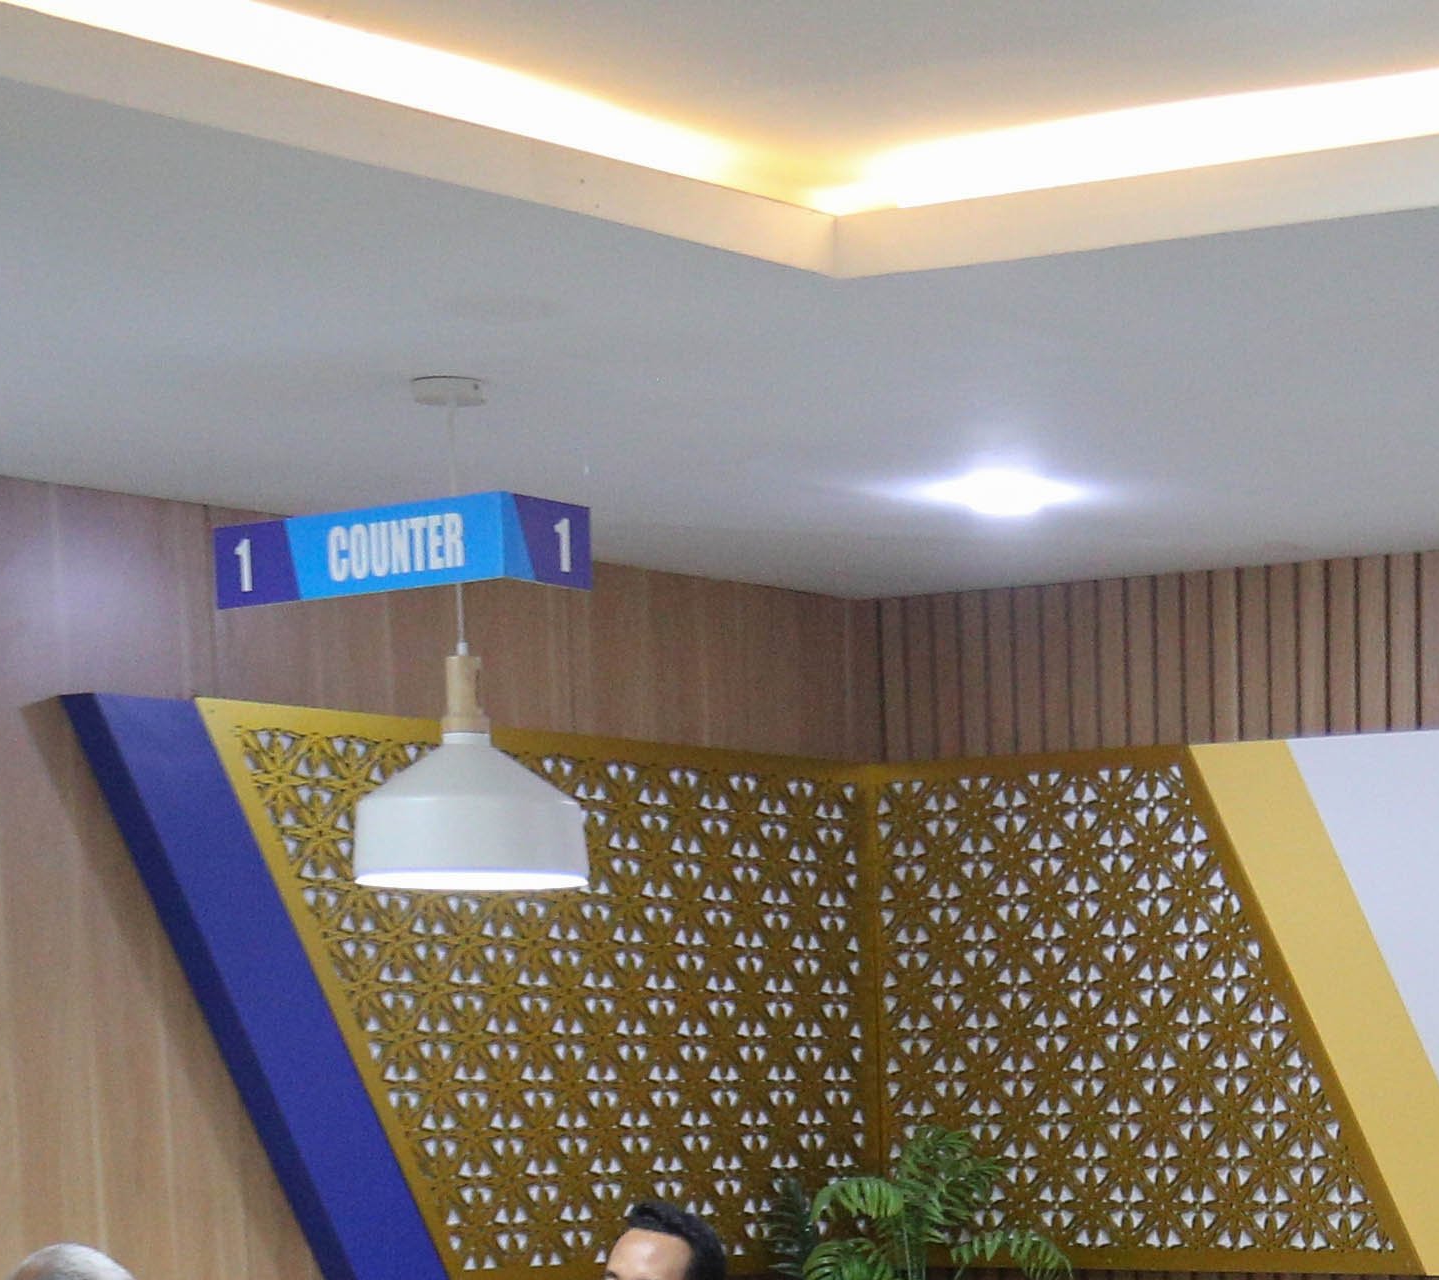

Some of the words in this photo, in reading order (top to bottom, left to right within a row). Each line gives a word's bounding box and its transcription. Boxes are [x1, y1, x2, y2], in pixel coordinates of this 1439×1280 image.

[233, 538, 253, 593] 1
[327, 512, 465, 583] COUNTER
[553, 517, 571, 573] 1
